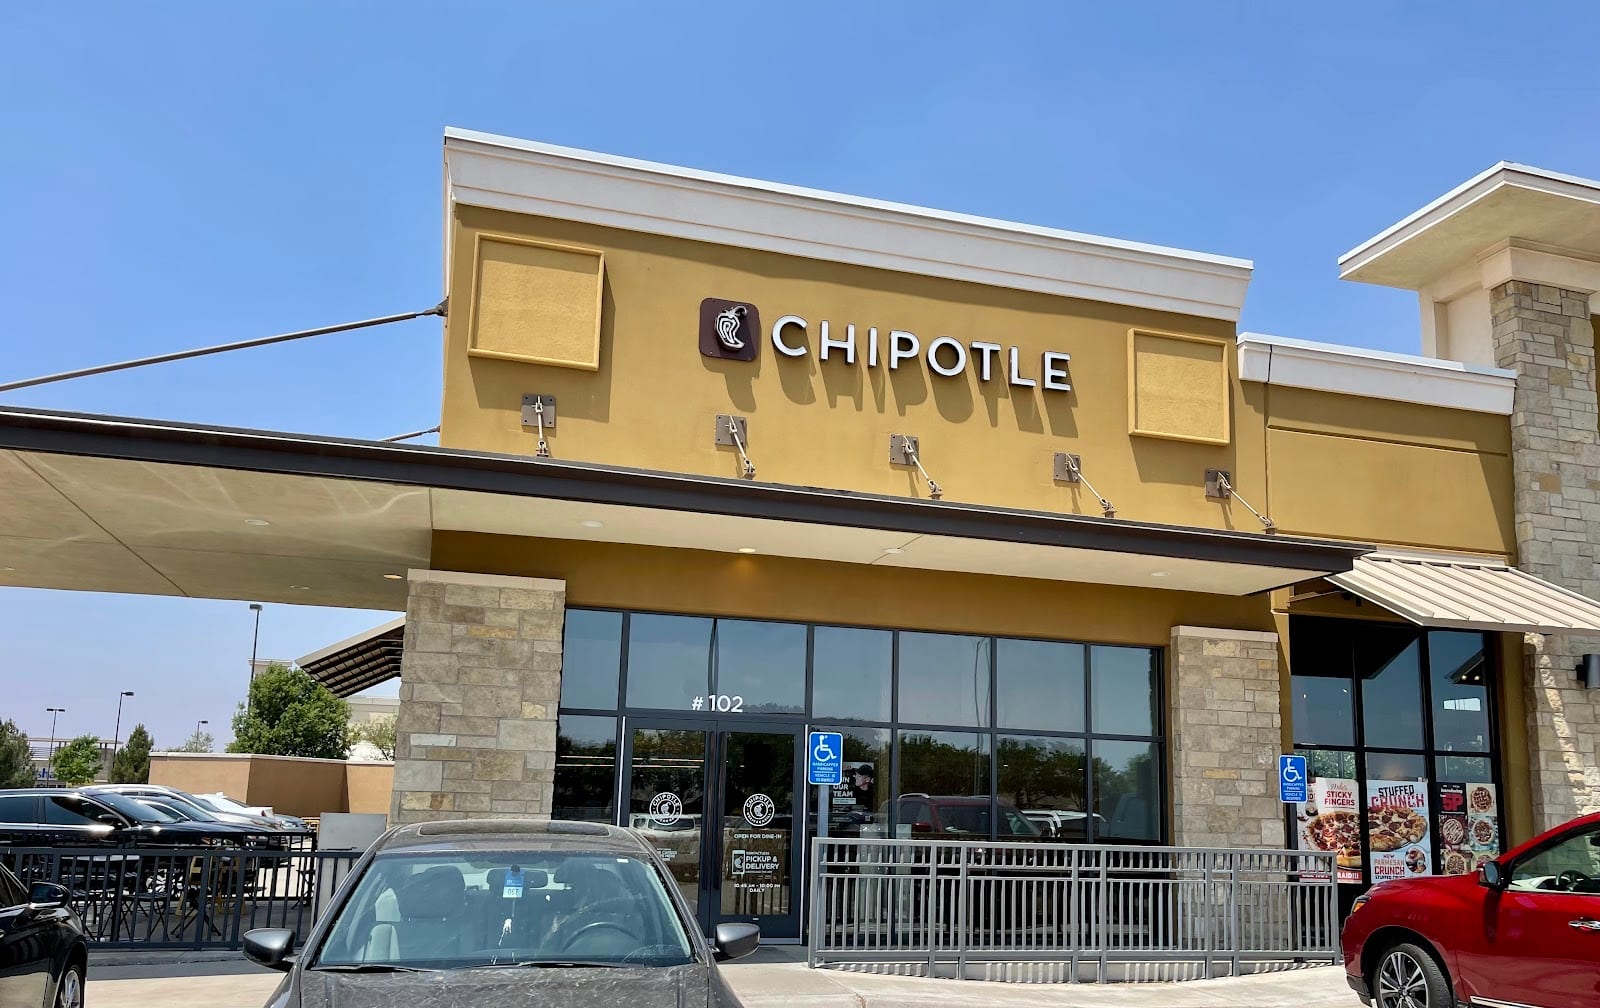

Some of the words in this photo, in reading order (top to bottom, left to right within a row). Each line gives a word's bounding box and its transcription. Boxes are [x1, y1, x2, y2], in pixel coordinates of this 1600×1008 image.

[771, 314, 1072, 392] CHIPOTLE
[709, 694, 744, 713] 102
[1326, 791, 1353, 799] STICKY
[1378, 785, 1415, 798] STUFFED
[1324, 798, 1356, 806] FINGERS
[1371, 794, 1425, 808] CRUNCH
[745, 855, 772, 863] PICKUP
[772, 855, 778, 863] &
[745, 862, 780, 870] DELIVERY
[1374, 866, 1406, 875] CRUNCH
[1337, 871, 1359, 879] RAID!!!
